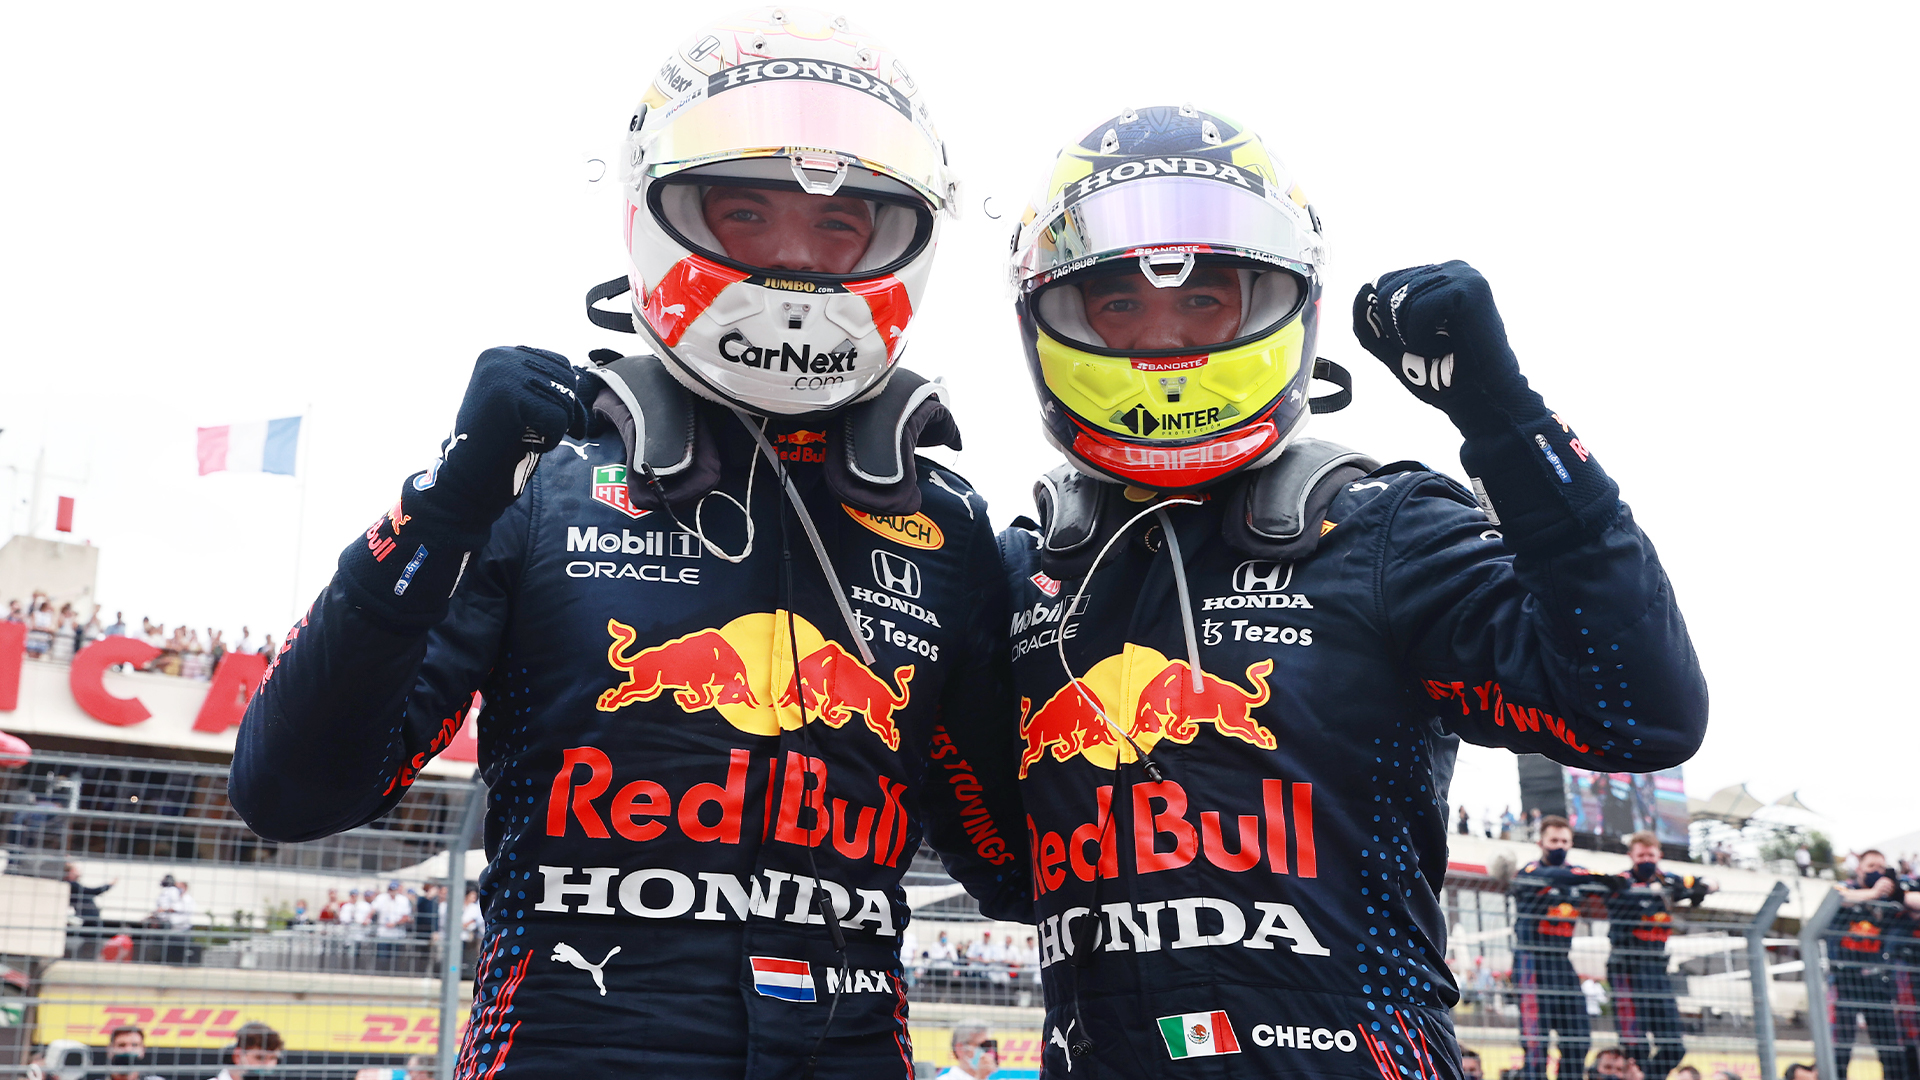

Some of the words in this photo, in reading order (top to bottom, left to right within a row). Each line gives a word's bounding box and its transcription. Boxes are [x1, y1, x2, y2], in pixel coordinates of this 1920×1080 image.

[724, 60, 902, 110] HONDA
[1077, 157, 1252, 198] HONDA
[1144, 245, 1200, 255] BANORTE
[718, 331, 858, 375] CarNext
[1148, 359, 1203, 371] BANORTE
[790, 375, 845, 391] .com
[1162, 406, 1220, 430] INTER
[803, 447, 827, 463] Bul
[1546, 450, 1568, 479] BIOTECH
[601, 467, 627, 482] T
[566, 526, 663, 556] Mobil
[404, 551, 425, 579] BIOTECH
[565, 560, 701, 585] ORACLE
[851, 585, 942, 628] HONDA
[1201, 594, 1314, 610] HONDA
[1009, 599, 1064, 638] Mobil
[1230, 619, 1314, 646] Tezos
[880, 619, 940, 662] Tezos
[1011, 622, 1080, 663] ORACLE
[546, 746, 750, 845] Red
[764, 750, 909, 869] Bull
[1026, 785, 1119, 901] Red
[1132, 779, 1318, 879] Bull
[534, 864, 897, 937] HONDA
[1038, 897, 1331, 969] HONDA
[826, 966, 893, 995] MAX
[99, 1007, 240, 1038] DHL
[1251, 1023, 1358, 1053] CHECO
